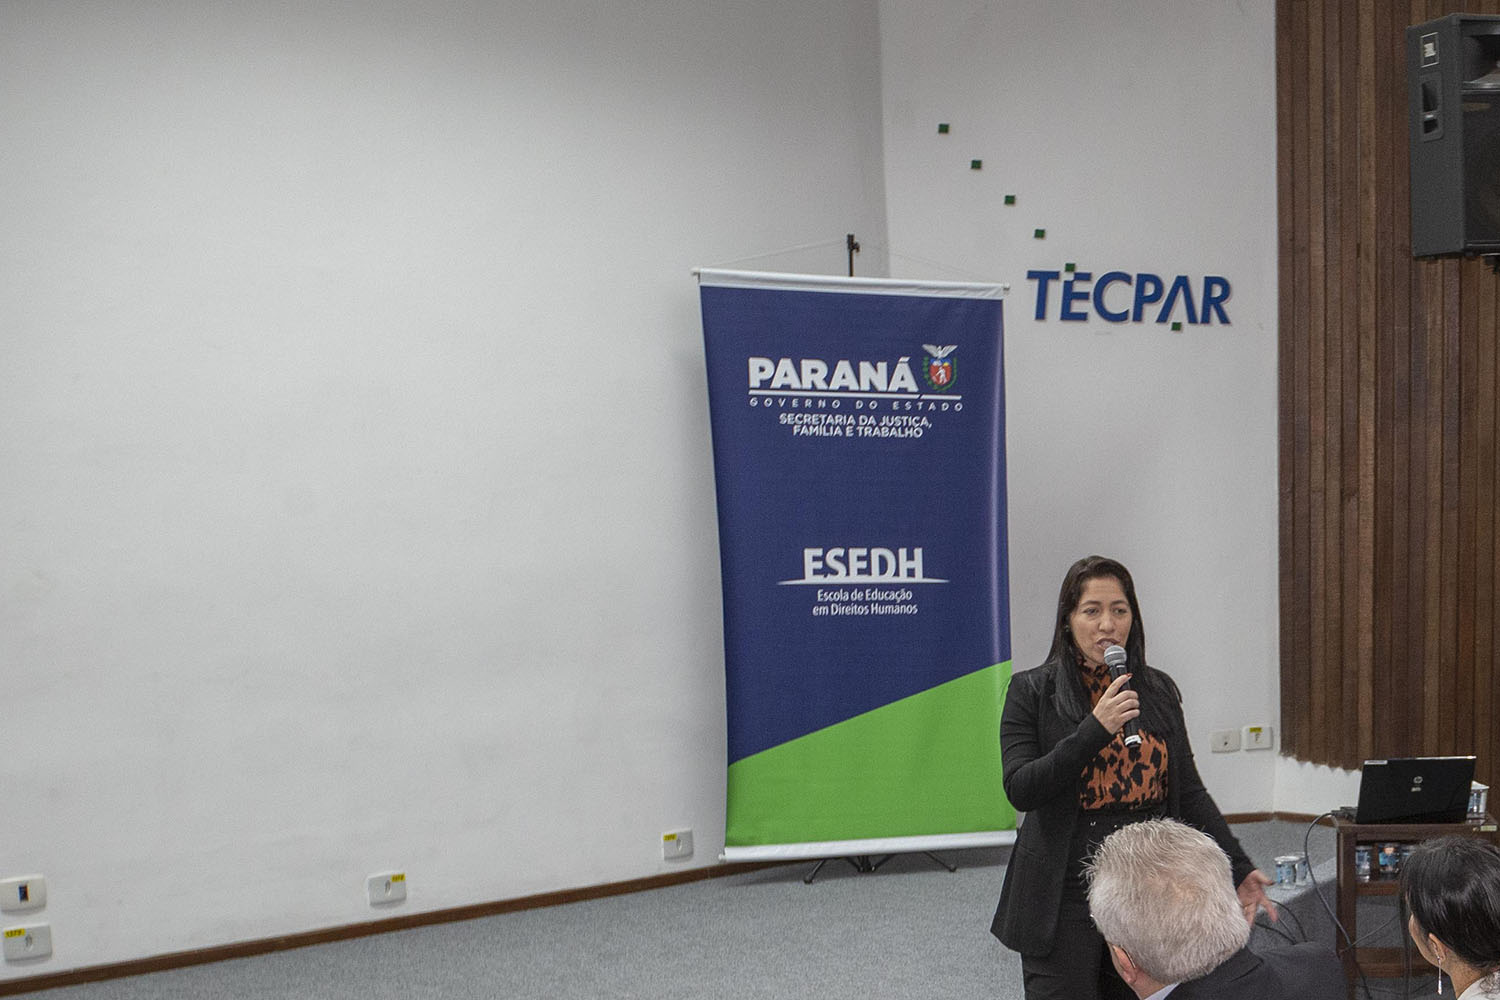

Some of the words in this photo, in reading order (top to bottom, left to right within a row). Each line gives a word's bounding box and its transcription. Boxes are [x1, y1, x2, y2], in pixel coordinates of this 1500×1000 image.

[1026, 270, 1232, 325] TECPAR
[748, 356, 919, 392] PARANÁ
[749, 397, 841, 409] GOVERNO
[855, 400, 878, 410] DO
[892, 401, 963, 412] ESTADO
[779, 413, 856, 426] SECRETARIA
[859, 414, 876, 426] DA
[879, 415, 933, 429] JUSTIÇA,
[793, 423, 843, 436] FAMÍLIA
[846, 426, 854, 437] E
[856, 426, 924, 438] TRABALHO
[803, 547, 924, 581] ESEDH
[817, 588, 850, 602] Escola
[850, 588, 864, 602] de
[865, 588, 913, 603] Educação
[812, 605, 829, 616] em
[831, 603, 869, 616] Direitos
[870, 603, 918, 616] Humanos
